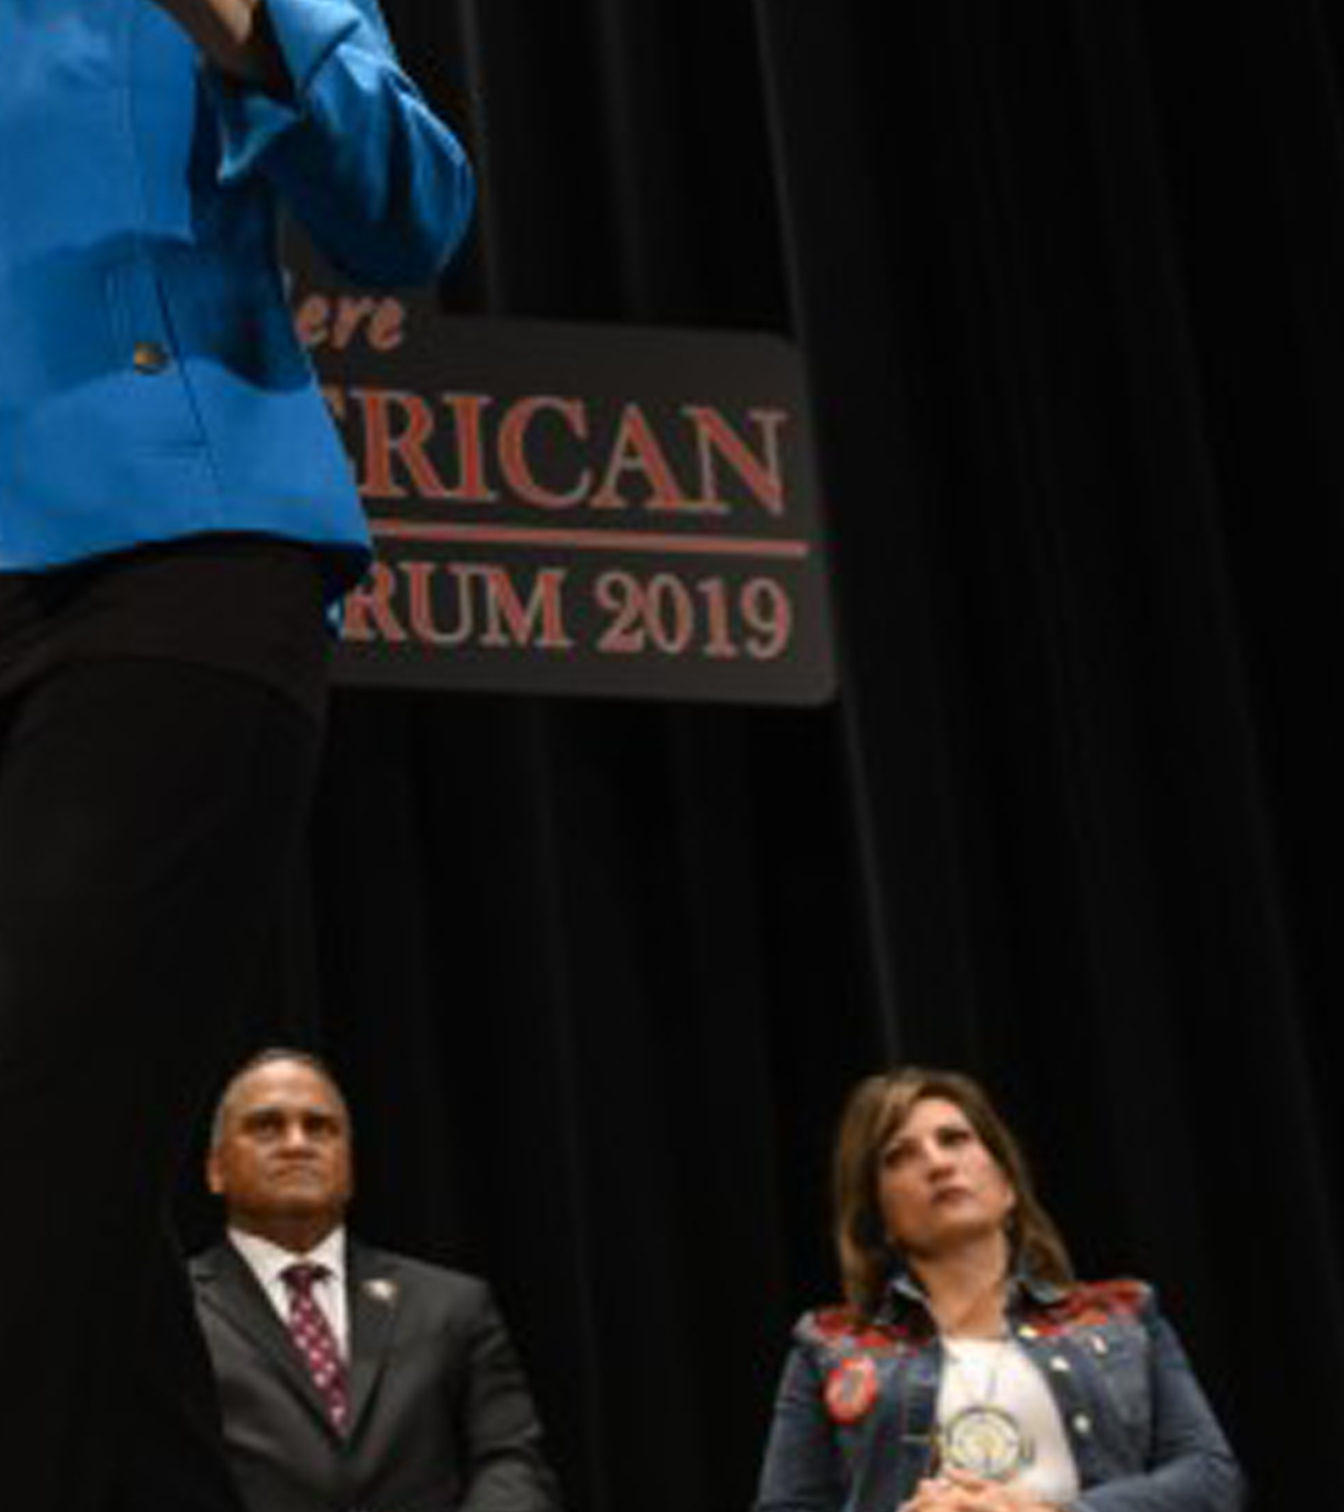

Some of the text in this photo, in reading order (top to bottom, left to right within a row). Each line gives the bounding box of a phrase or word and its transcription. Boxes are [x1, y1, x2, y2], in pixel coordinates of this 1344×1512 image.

[296, 294, 404, 352] ere
[324, 384, 790, 517] RICAN
[342, 560, 568, 651] RUM
[595, 570, 792, 661] 2019
